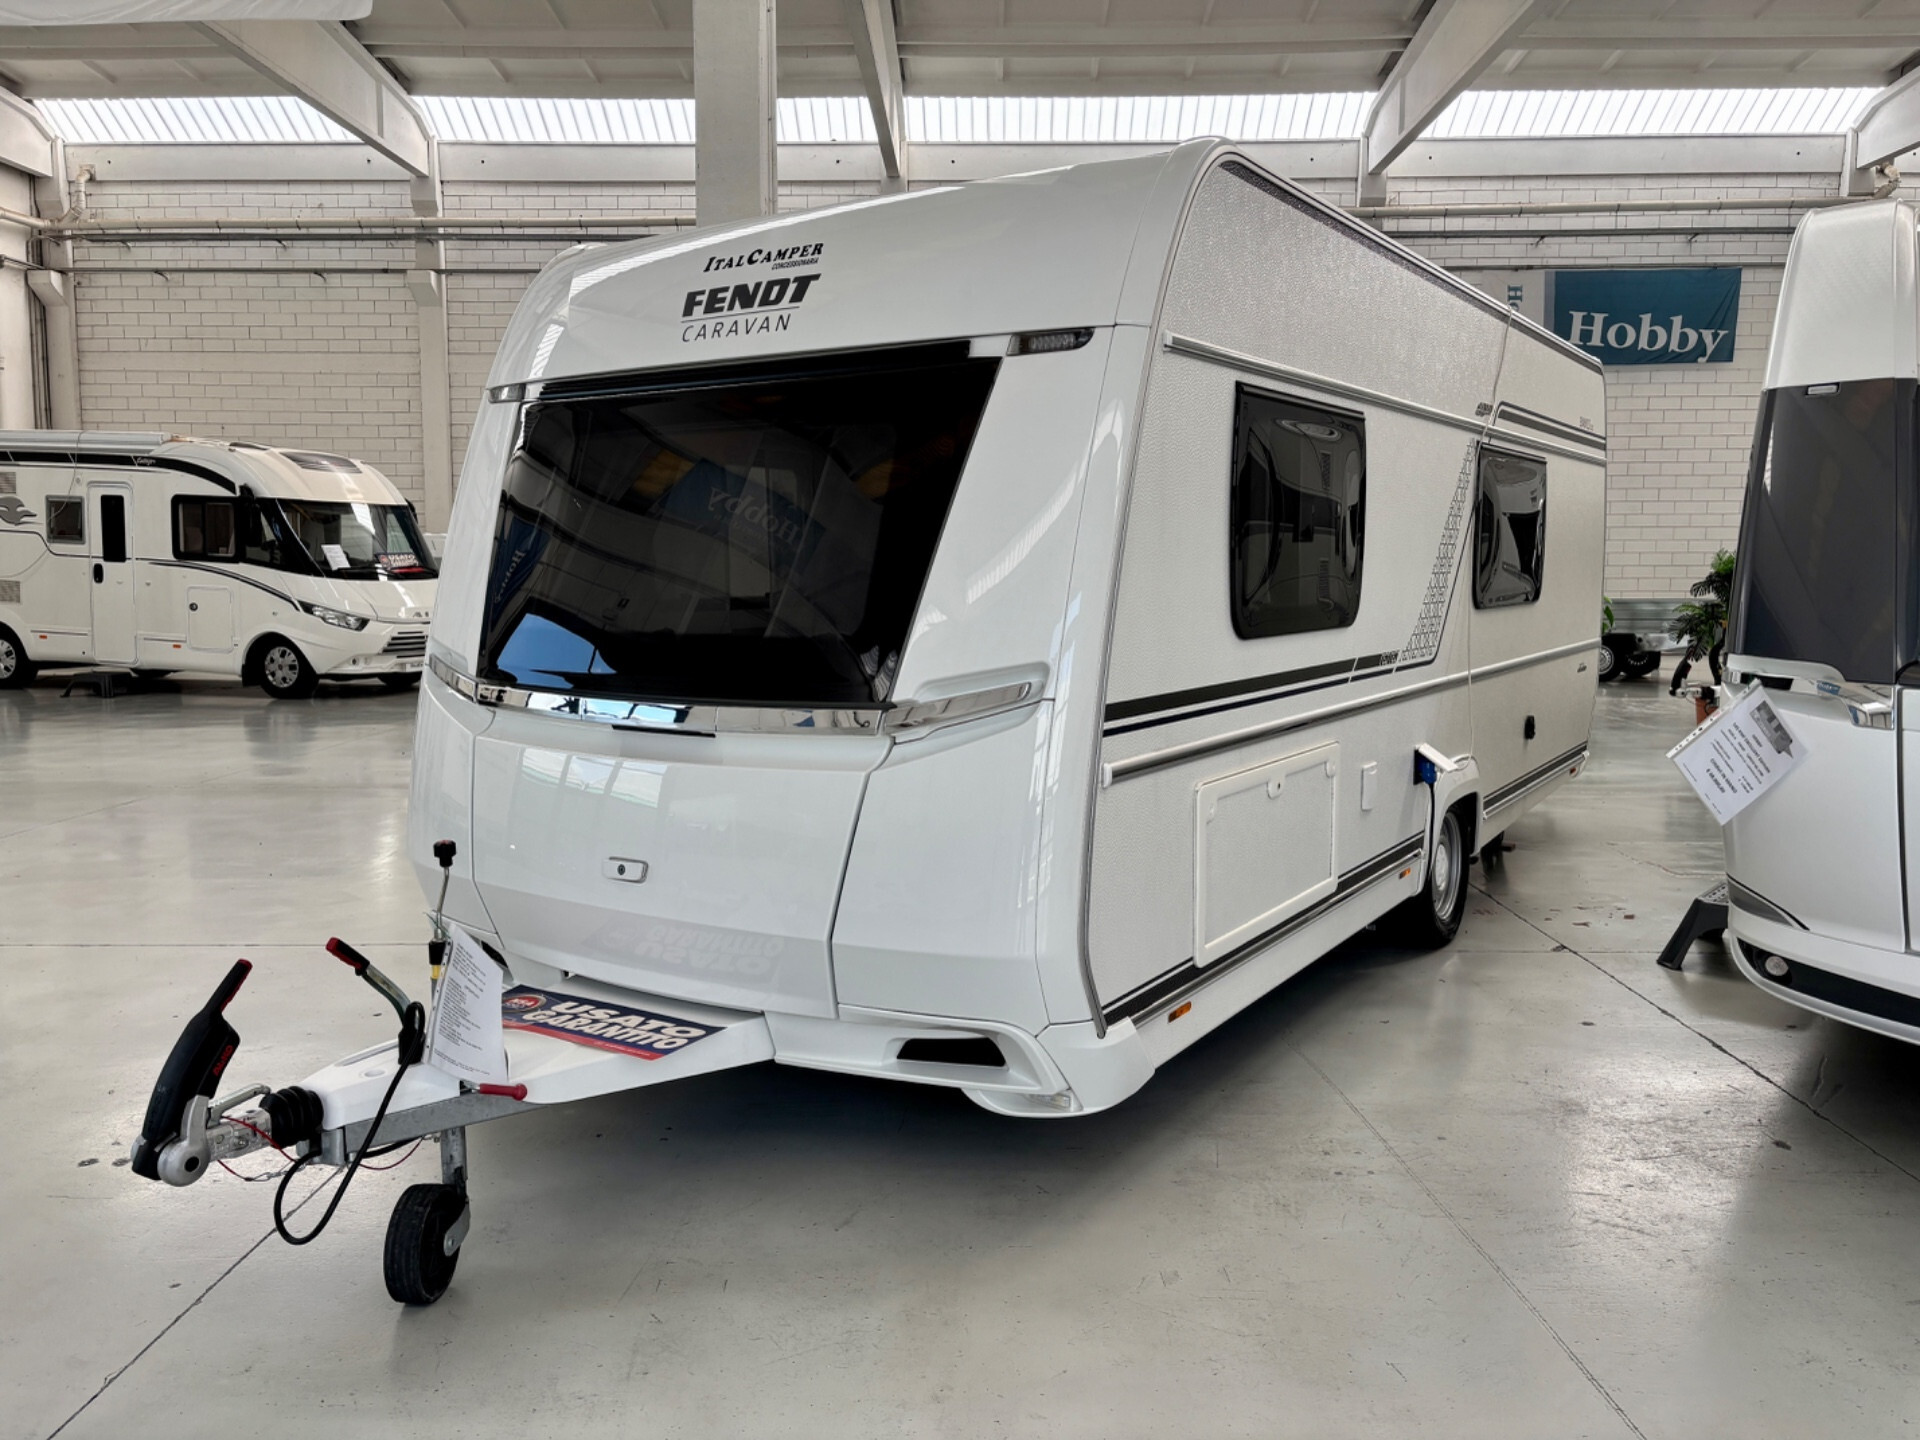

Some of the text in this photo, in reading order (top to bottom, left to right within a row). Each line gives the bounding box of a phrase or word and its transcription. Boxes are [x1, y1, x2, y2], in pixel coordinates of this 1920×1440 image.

[682, 273, 822, 318] FENDT
[681, 313, 791, 342] CARAVAN
[1568, 310, 1729, 363] Hobby
[521, 1009, 690, 1050] GARANTITO
[551, 1000, 707, 1039] USATO
